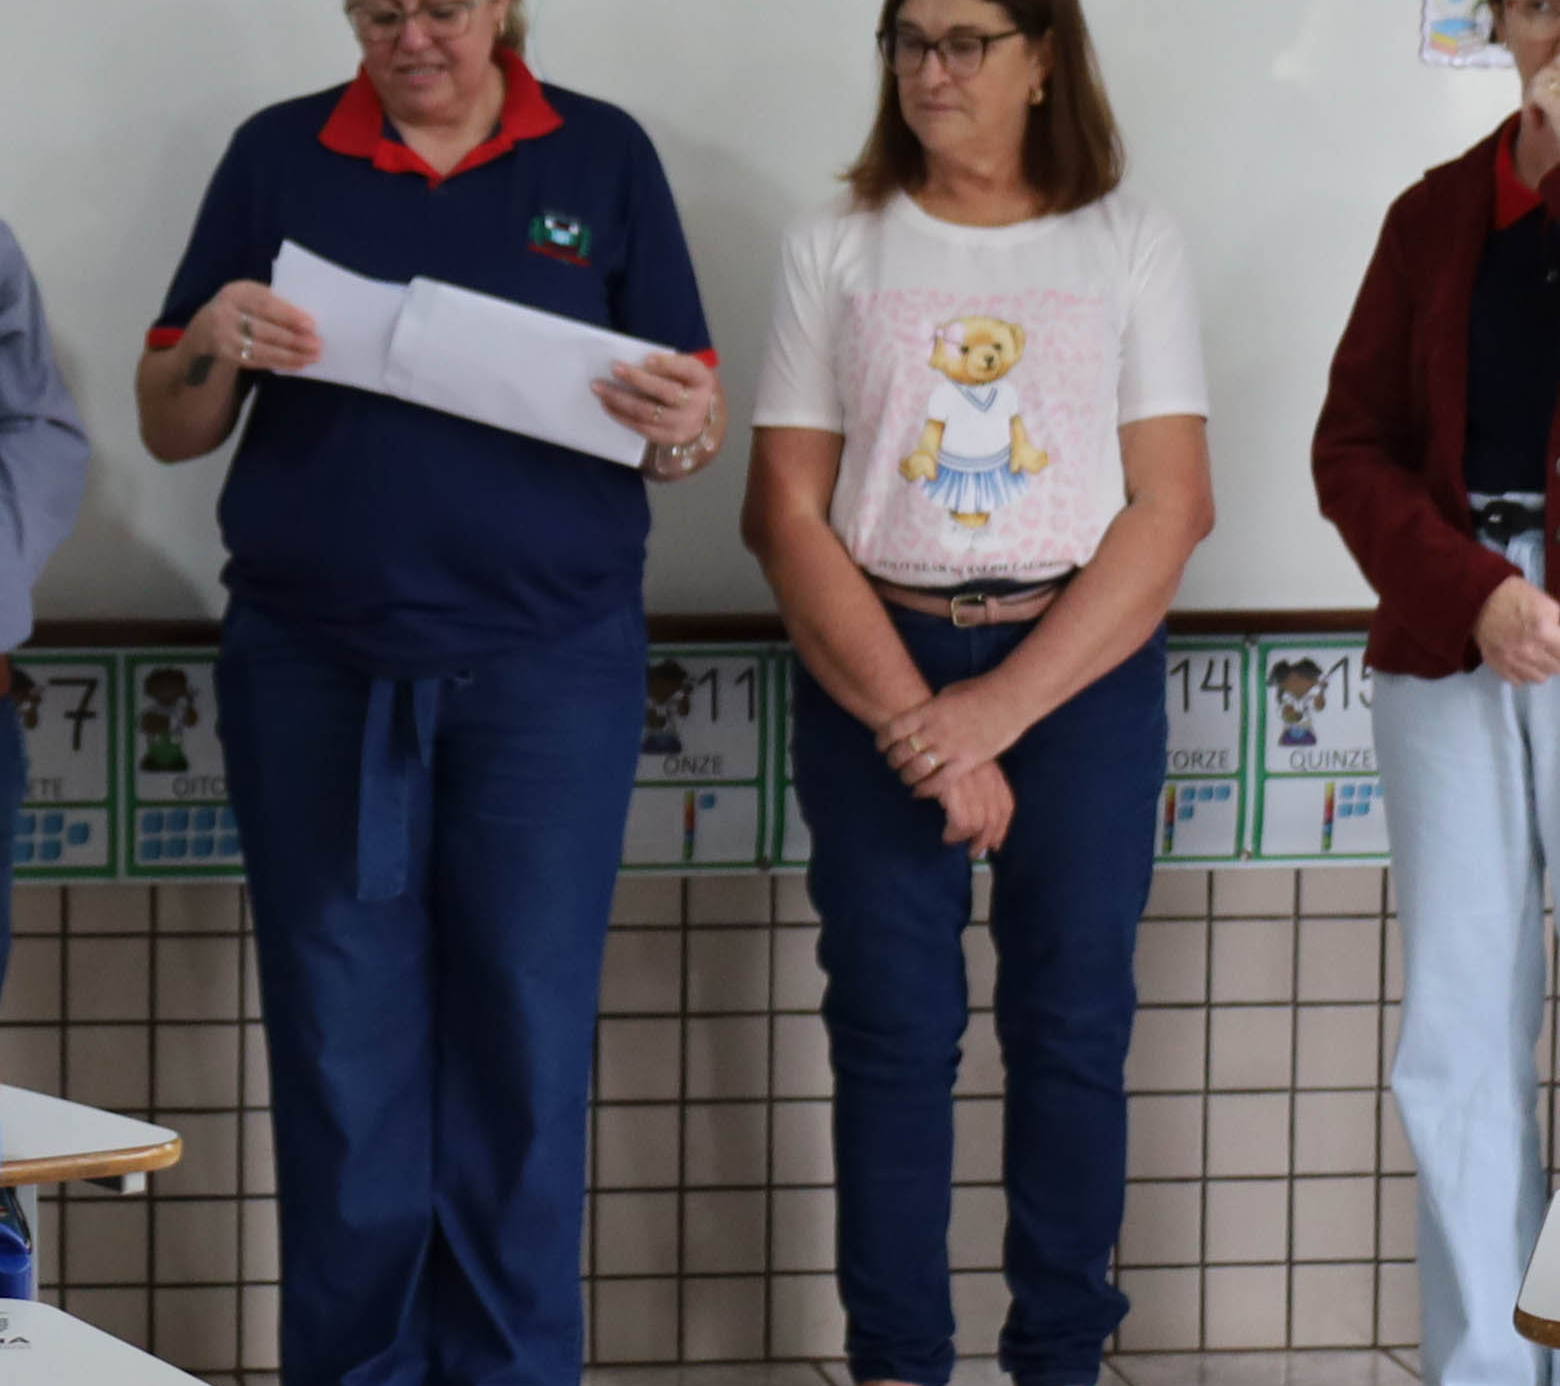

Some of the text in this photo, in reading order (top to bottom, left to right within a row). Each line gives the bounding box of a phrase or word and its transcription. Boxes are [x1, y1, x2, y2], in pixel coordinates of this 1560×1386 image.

[697, 667, 755, 722] 11
[1170, 658, 1232, 712] 14
[48, 678, 99, 752] 7
[663, 754, 722, 776] ONZE
[1290, 748, 1370, 771] QUINZE
